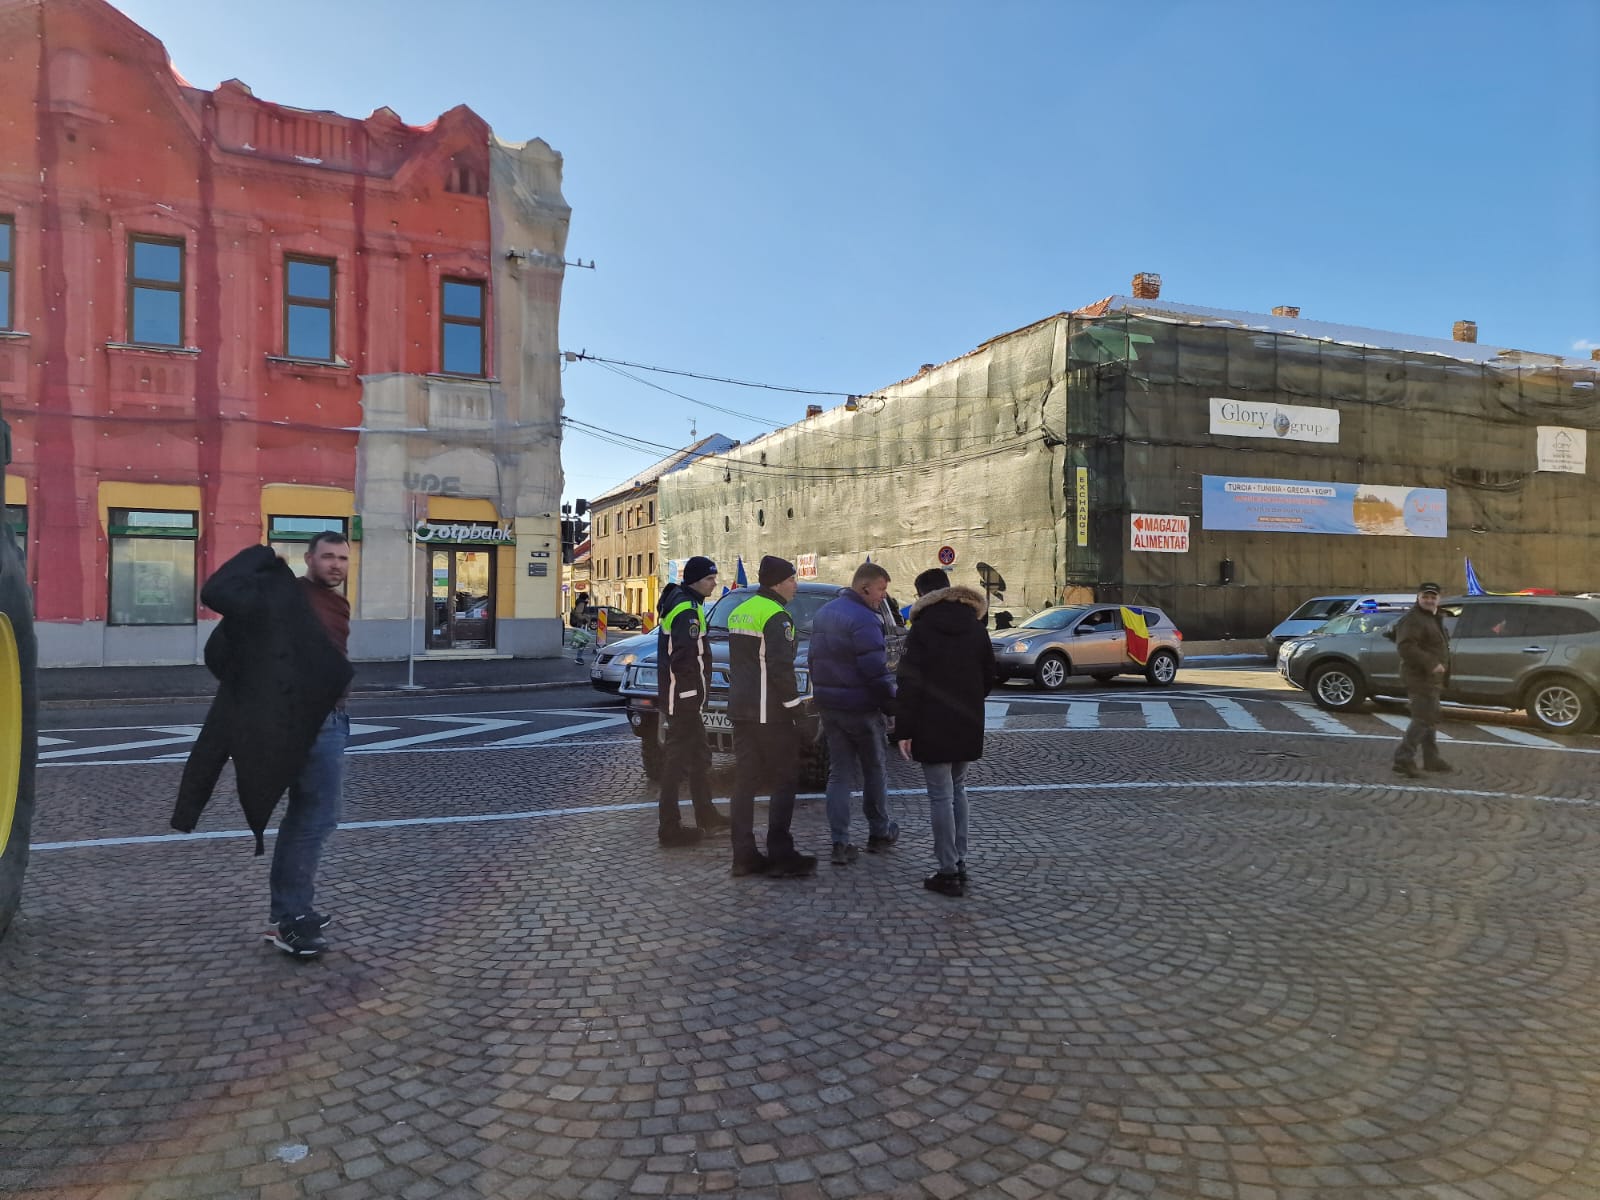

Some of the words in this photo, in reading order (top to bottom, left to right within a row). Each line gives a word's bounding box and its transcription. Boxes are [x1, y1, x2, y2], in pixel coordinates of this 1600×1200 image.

[1221, 402, 1268, 430] Glory
[1290, 422, 1323, 436] grup
[1228, 483, 1251, 491] TURCIA
[1287, 486, 1310, 494] GRECIA
[1144, 517, 1187, 532] MAGAZIN
[438, 522, 512, 544] otpbank
[1134, 534, 1187, 549] ALIMENTAR
